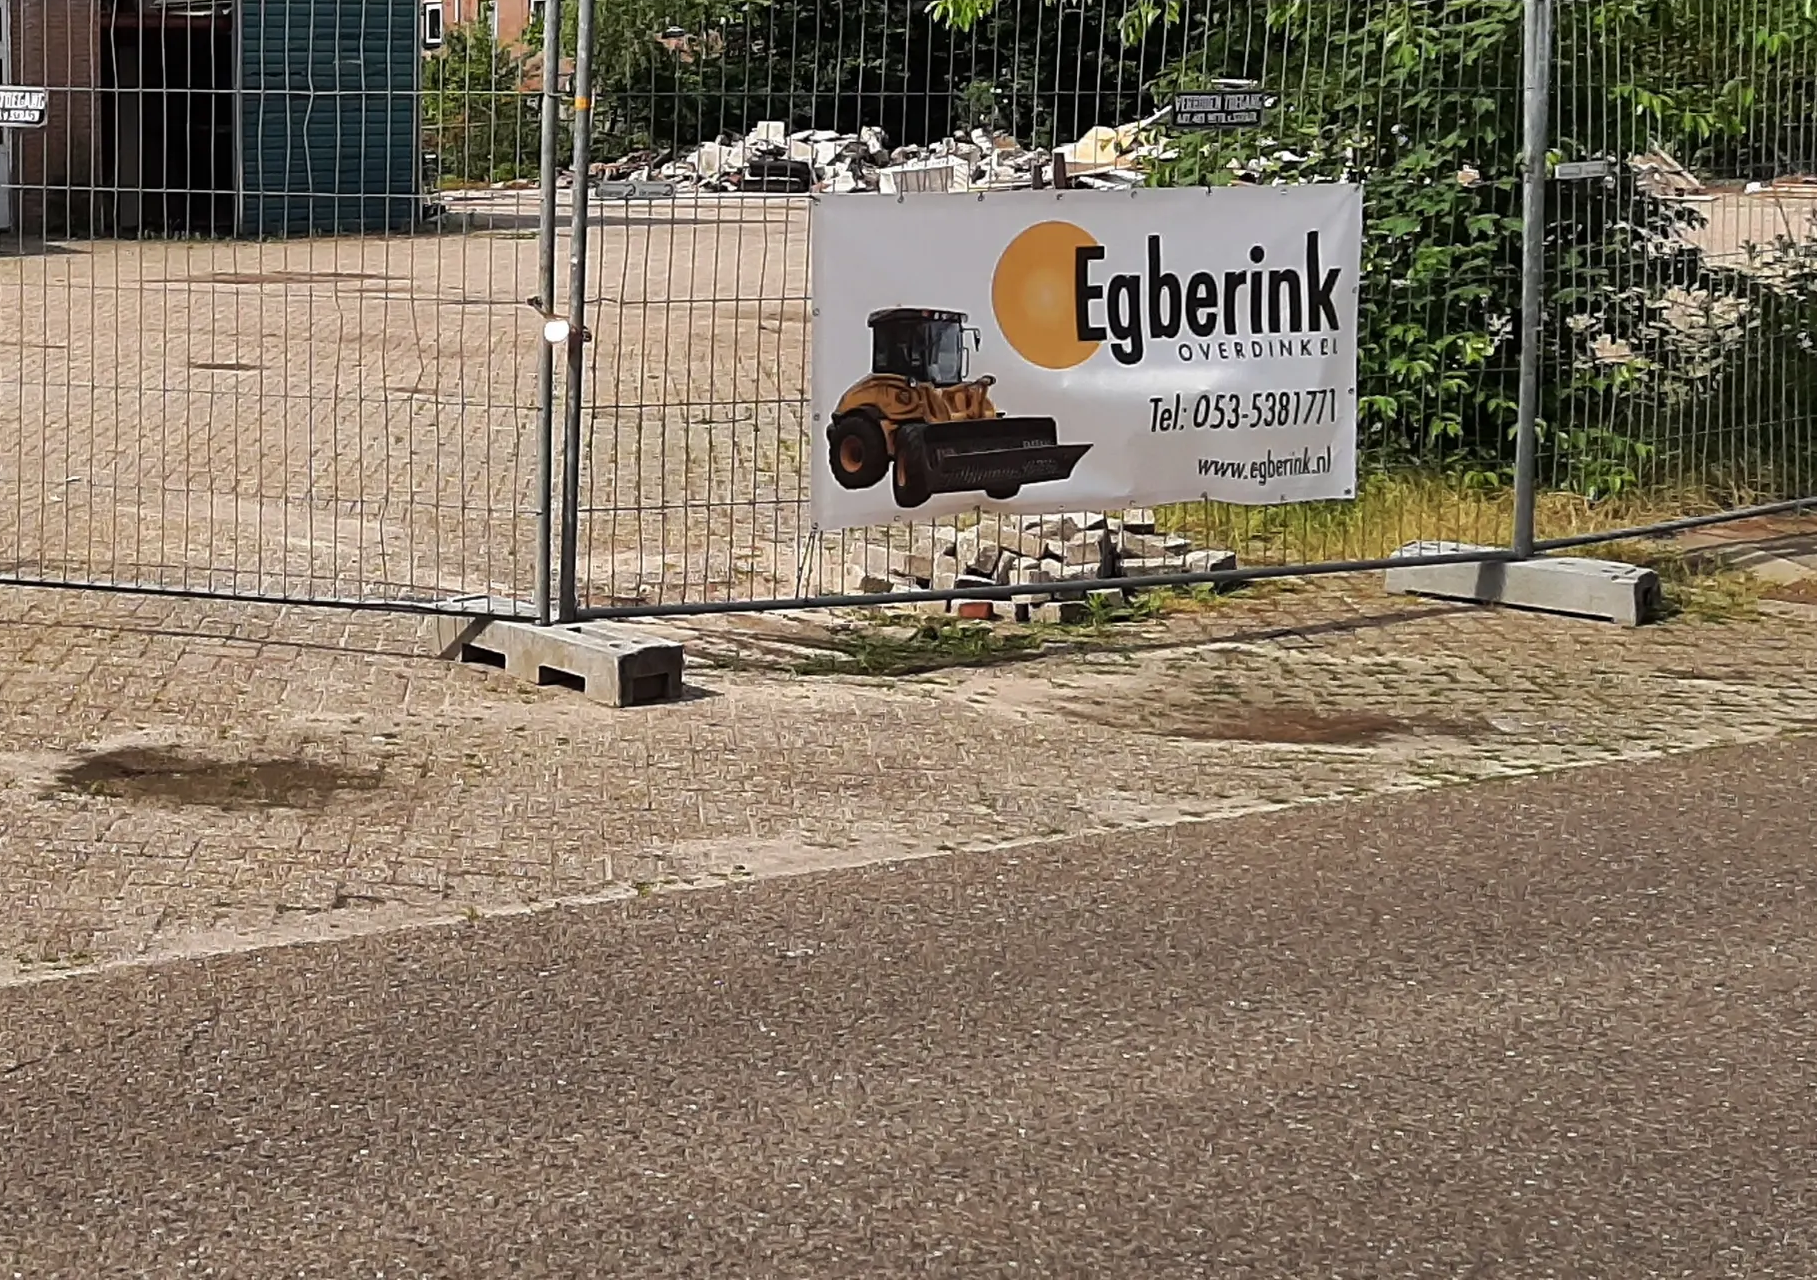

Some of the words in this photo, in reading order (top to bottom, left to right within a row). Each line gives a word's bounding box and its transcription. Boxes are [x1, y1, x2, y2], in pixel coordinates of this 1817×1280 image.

[1075, 230, 1342, 366] Egberink
[1178, 337, 1338, 362] OVERDINKEL
[1192, 387, 1336, 430] 053-5381771
[1197, 444, 1333, 486] www.egberink.nl
